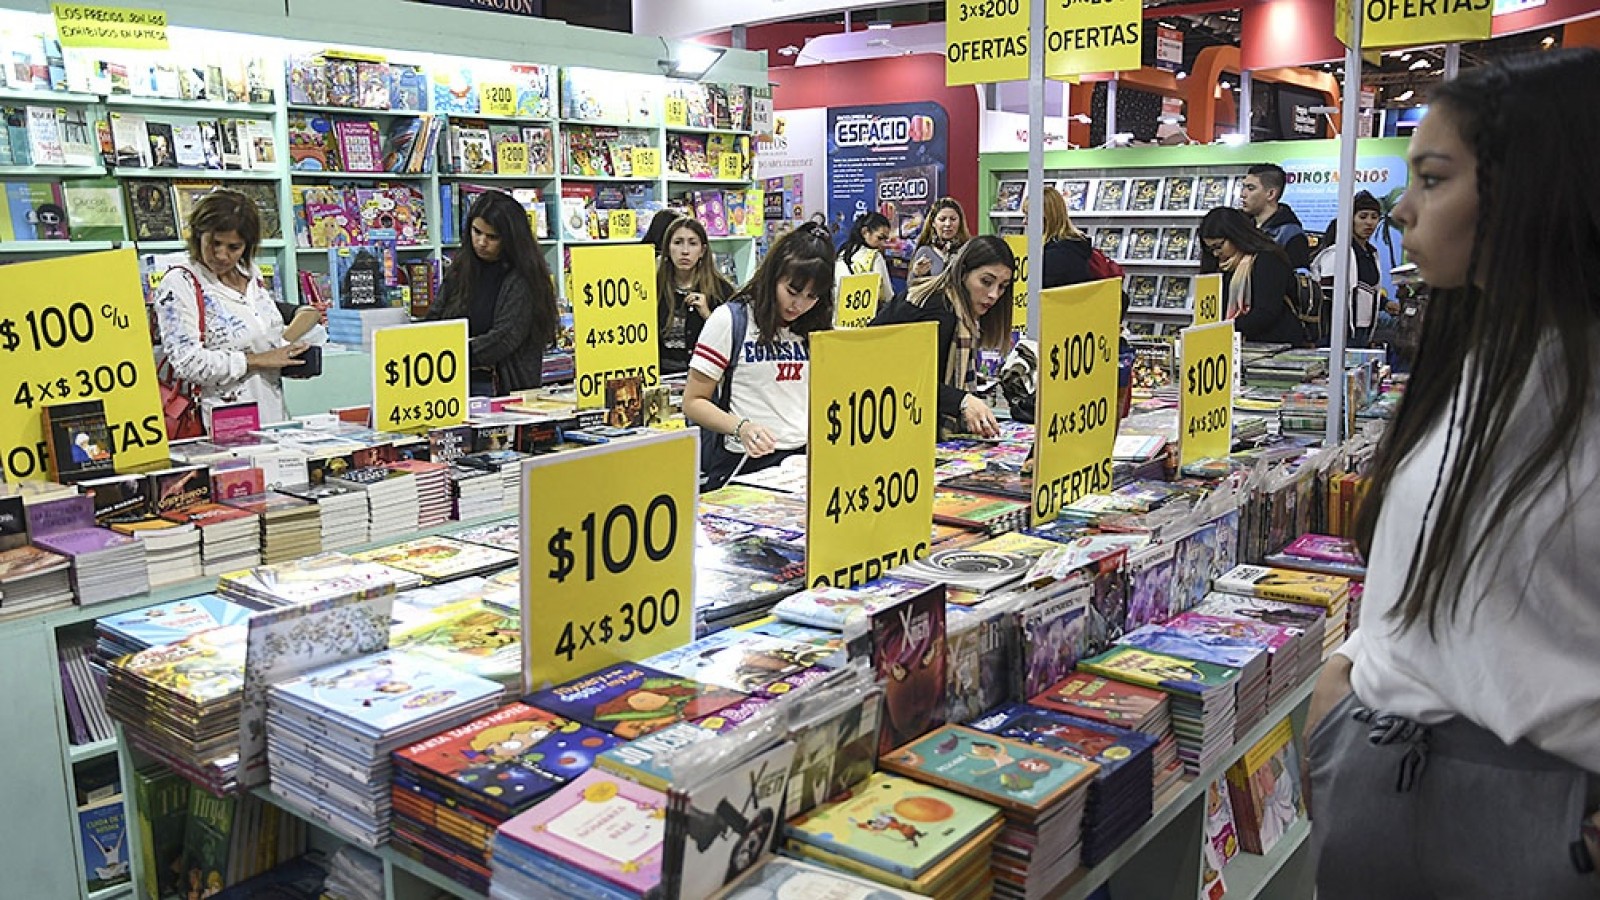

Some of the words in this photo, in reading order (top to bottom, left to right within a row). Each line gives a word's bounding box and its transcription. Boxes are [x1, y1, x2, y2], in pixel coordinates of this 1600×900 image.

[56, 5, 82, 20] LOS
[84, 8, 124, 22] PRECIOS
[129, 13, 146, 23] SON
[148, 14, 165, 26] LOS
[959, 0, 1019, 21] 3x$200
[947, 35, 1027, 62] OFERTAS
[1048, 23, 1139, 51] OFERTAS
[485, 87, 512, 102] $200
[837, 120, 906, 143] ESPACIO
[880, 181, 926, 198] ESPACIO
[1286, 169, 1389, 184] DINOSARIOS
[584, 278, 630, 309] $100
[846, 289, 871, 310] $80
[0, 302, 95, 352] $100
[101, 304, 130, 330] c/u
[586, 323, 648, 349] 4x$300
[385, 350, 457, 388] $100
[1049, 331, 1096, 381] $100
[14, 361, 137, 409] 4x$300
[776, 363, 803, 381] XIX
[1187, 354, 1228, 397] $100
[389, 397, 460, 426] 4x$300
[827, 385, 897, 447] $100
[903, 391, 923, 426] c/u
[1048, 397, 1108, 443] 4x$300
[1188, 406, 1227, 438] 4x$300
[7, 415, 163, 478] OFTAS
[825, 467, 919, 524] 4x$300
[1036, 458, 1110, 519] OFERTAS
[547, 494, 678, 584] $100
[554, 588, 680, 662] 4x$300
